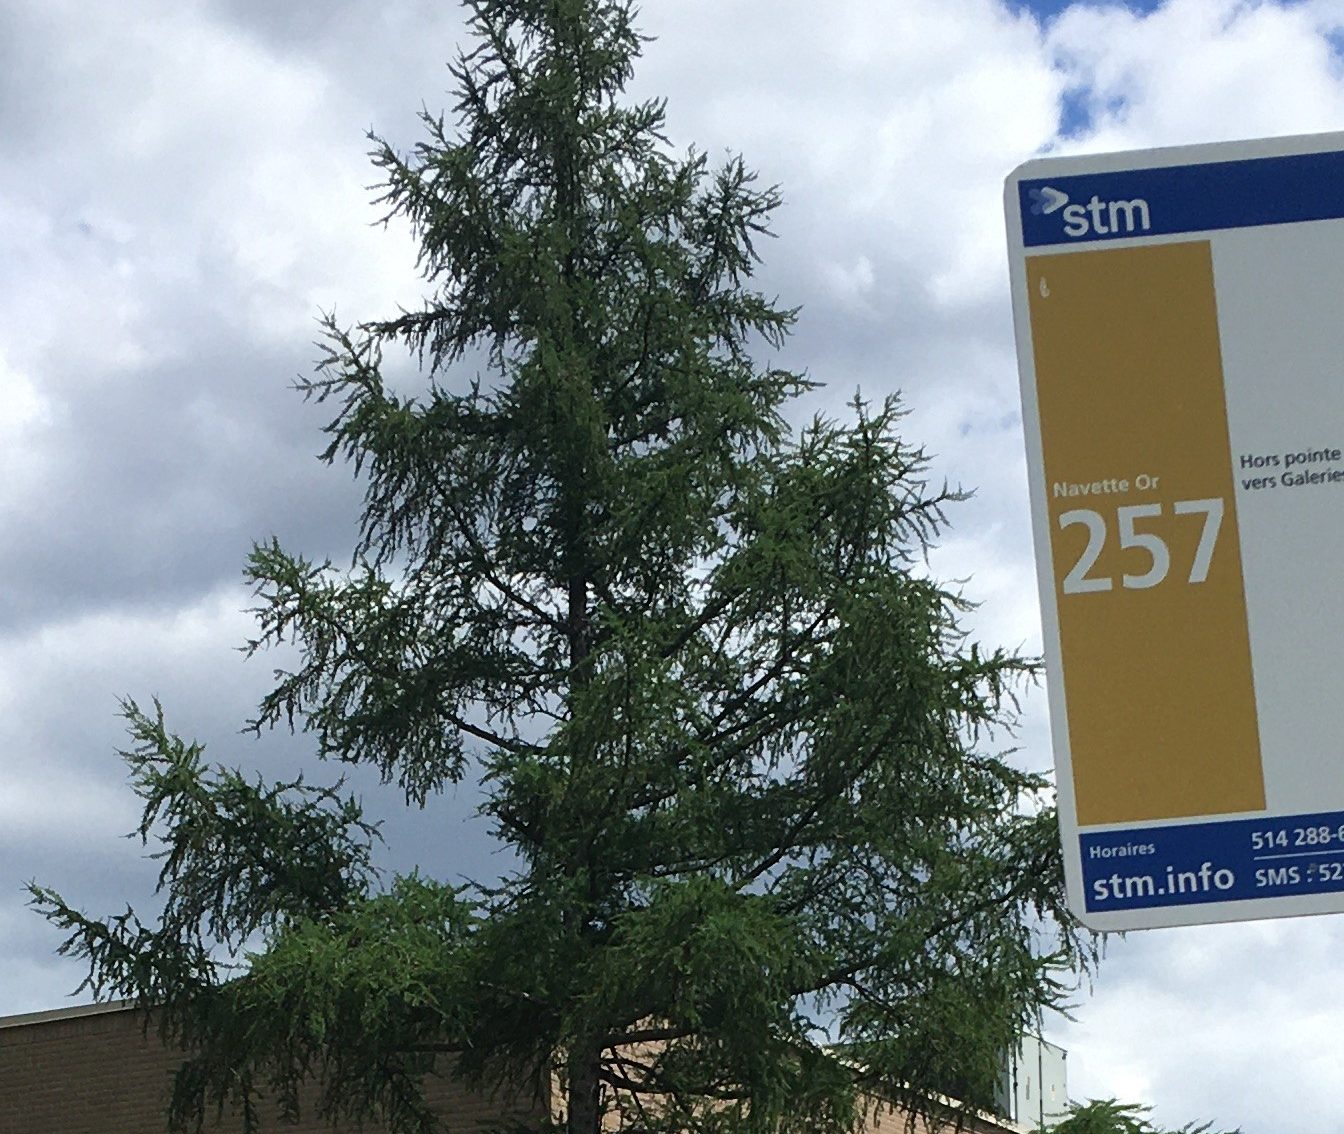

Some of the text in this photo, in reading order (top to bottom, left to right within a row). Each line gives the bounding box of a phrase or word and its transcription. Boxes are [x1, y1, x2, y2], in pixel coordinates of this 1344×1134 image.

[1063, 195, 1150, 237] stm
[1240, 446, 1342, 470] Hors pointe
[1053, 474, 1160, 499] Navette Or
[1242, 472, 1276, 490] vers
[1058, 498, 1224, 596] 257
[1089, 840, 1155, 859] Horaires
[1252, 830, 1288, 851] 514
[1093, 862, 1235, 901] stm.info
[1255, 866, 1300, 888] SMS
